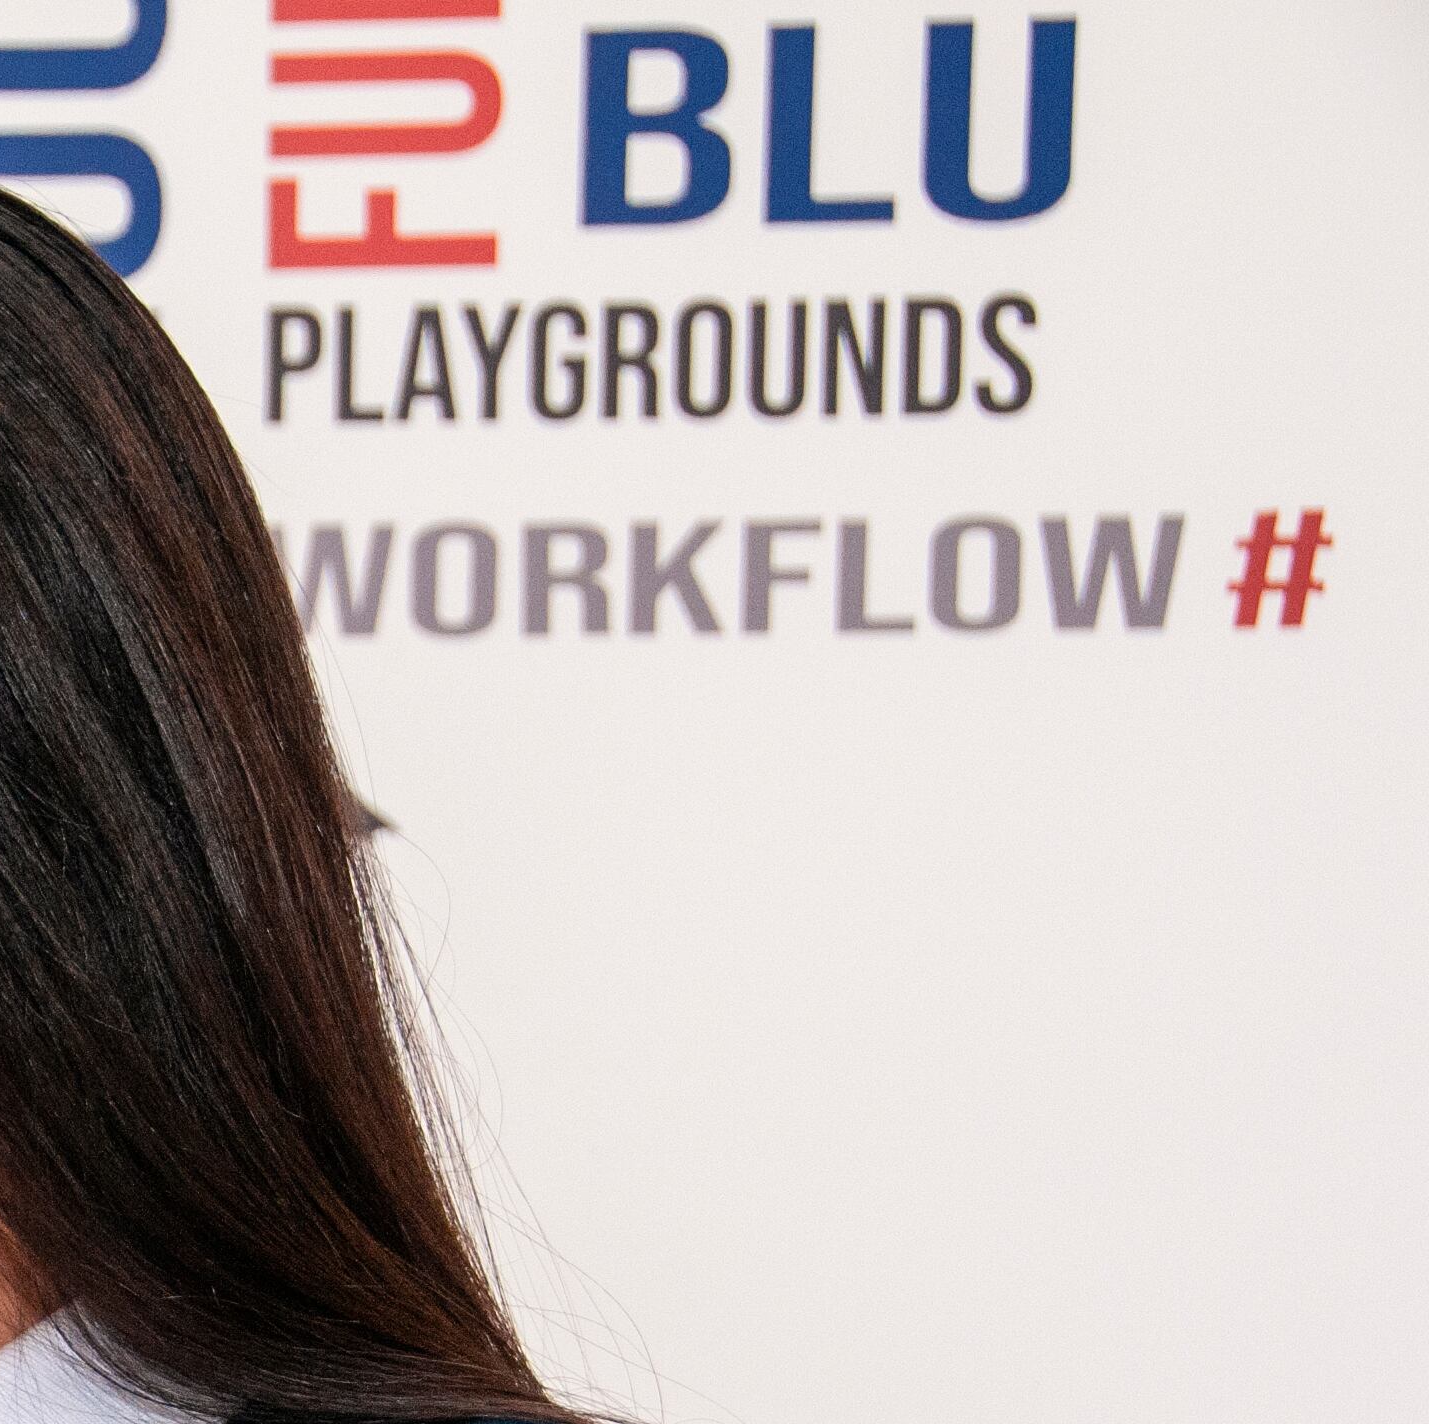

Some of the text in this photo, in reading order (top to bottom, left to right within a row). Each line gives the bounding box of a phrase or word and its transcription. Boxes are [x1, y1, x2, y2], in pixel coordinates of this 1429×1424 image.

[269, 0, 502, 269] FU
[580, 16, 1079, 226] BLU
[265, 294, 1039, 422] PLAYGROUNDS
[273, 512, 1188, 636] WORKFLOW
